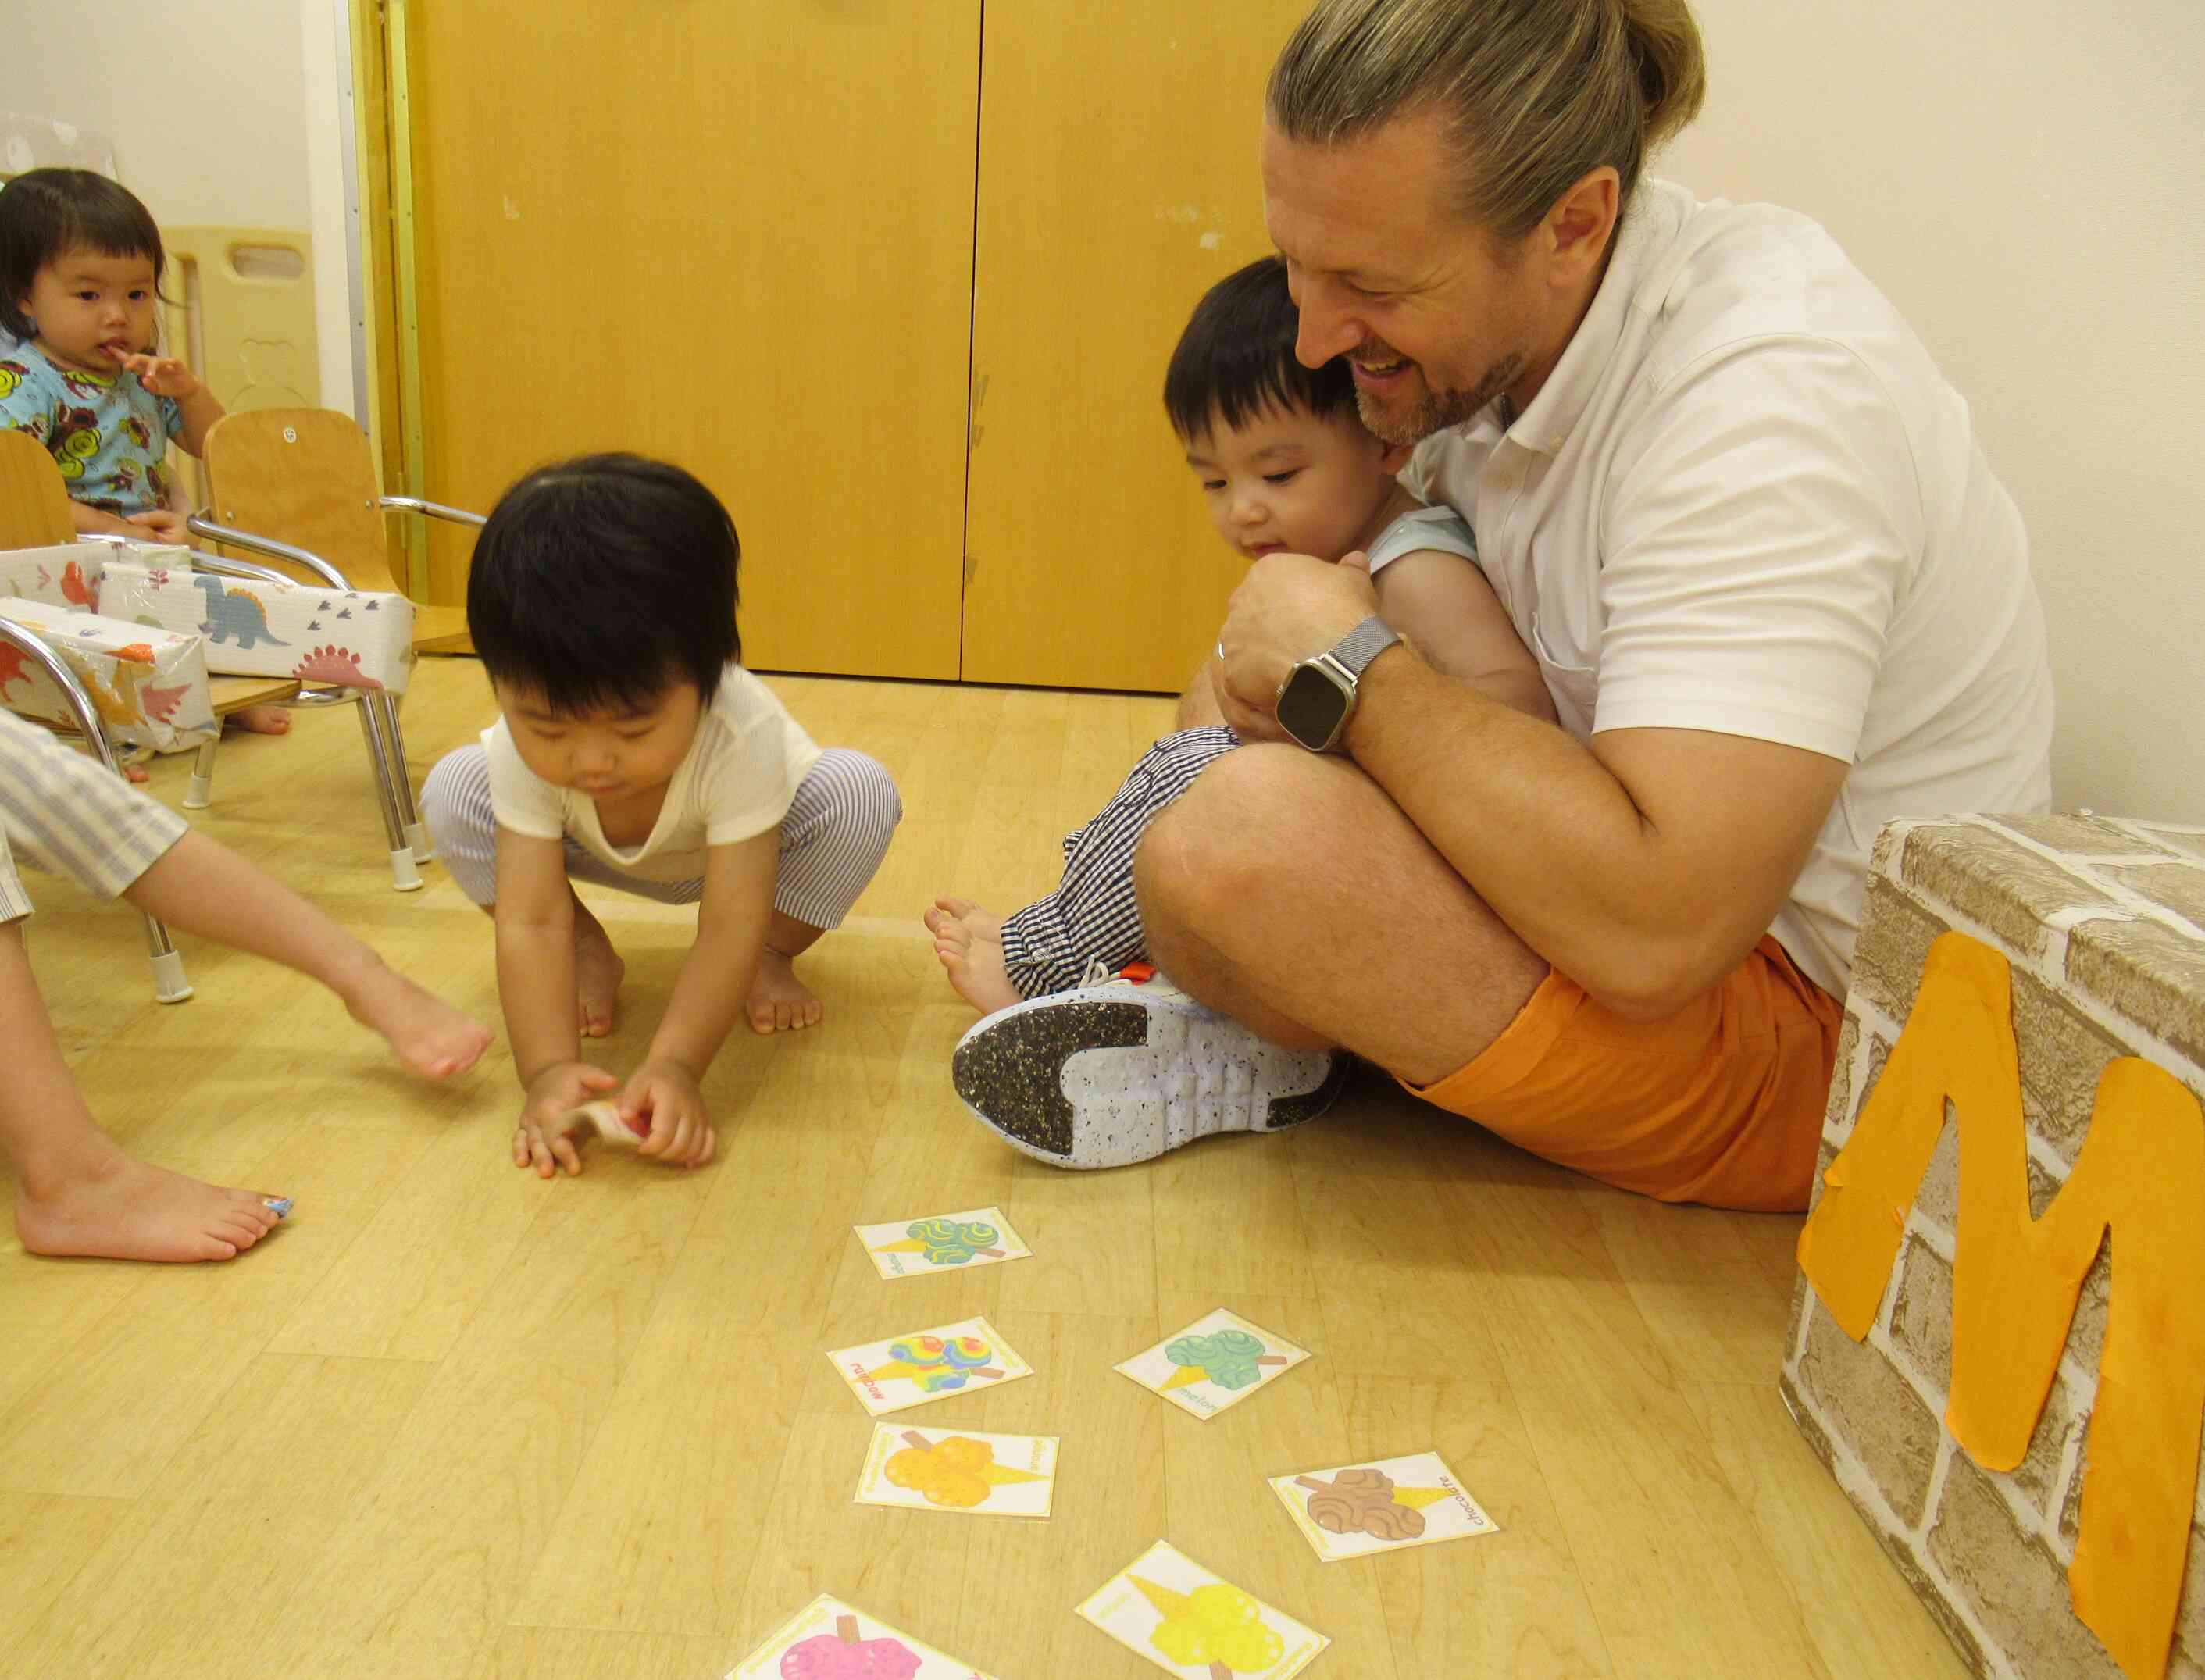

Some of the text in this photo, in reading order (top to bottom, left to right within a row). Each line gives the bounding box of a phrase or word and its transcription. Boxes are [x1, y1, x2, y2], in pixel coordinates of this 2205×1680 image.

[1796, 930, 2205, 1680] M
[850, 1362, 885, 1400] rainbow
[1179, 1387, 1218, 1411] melon
[1439, 1474, 1484, 1525] chocolate
